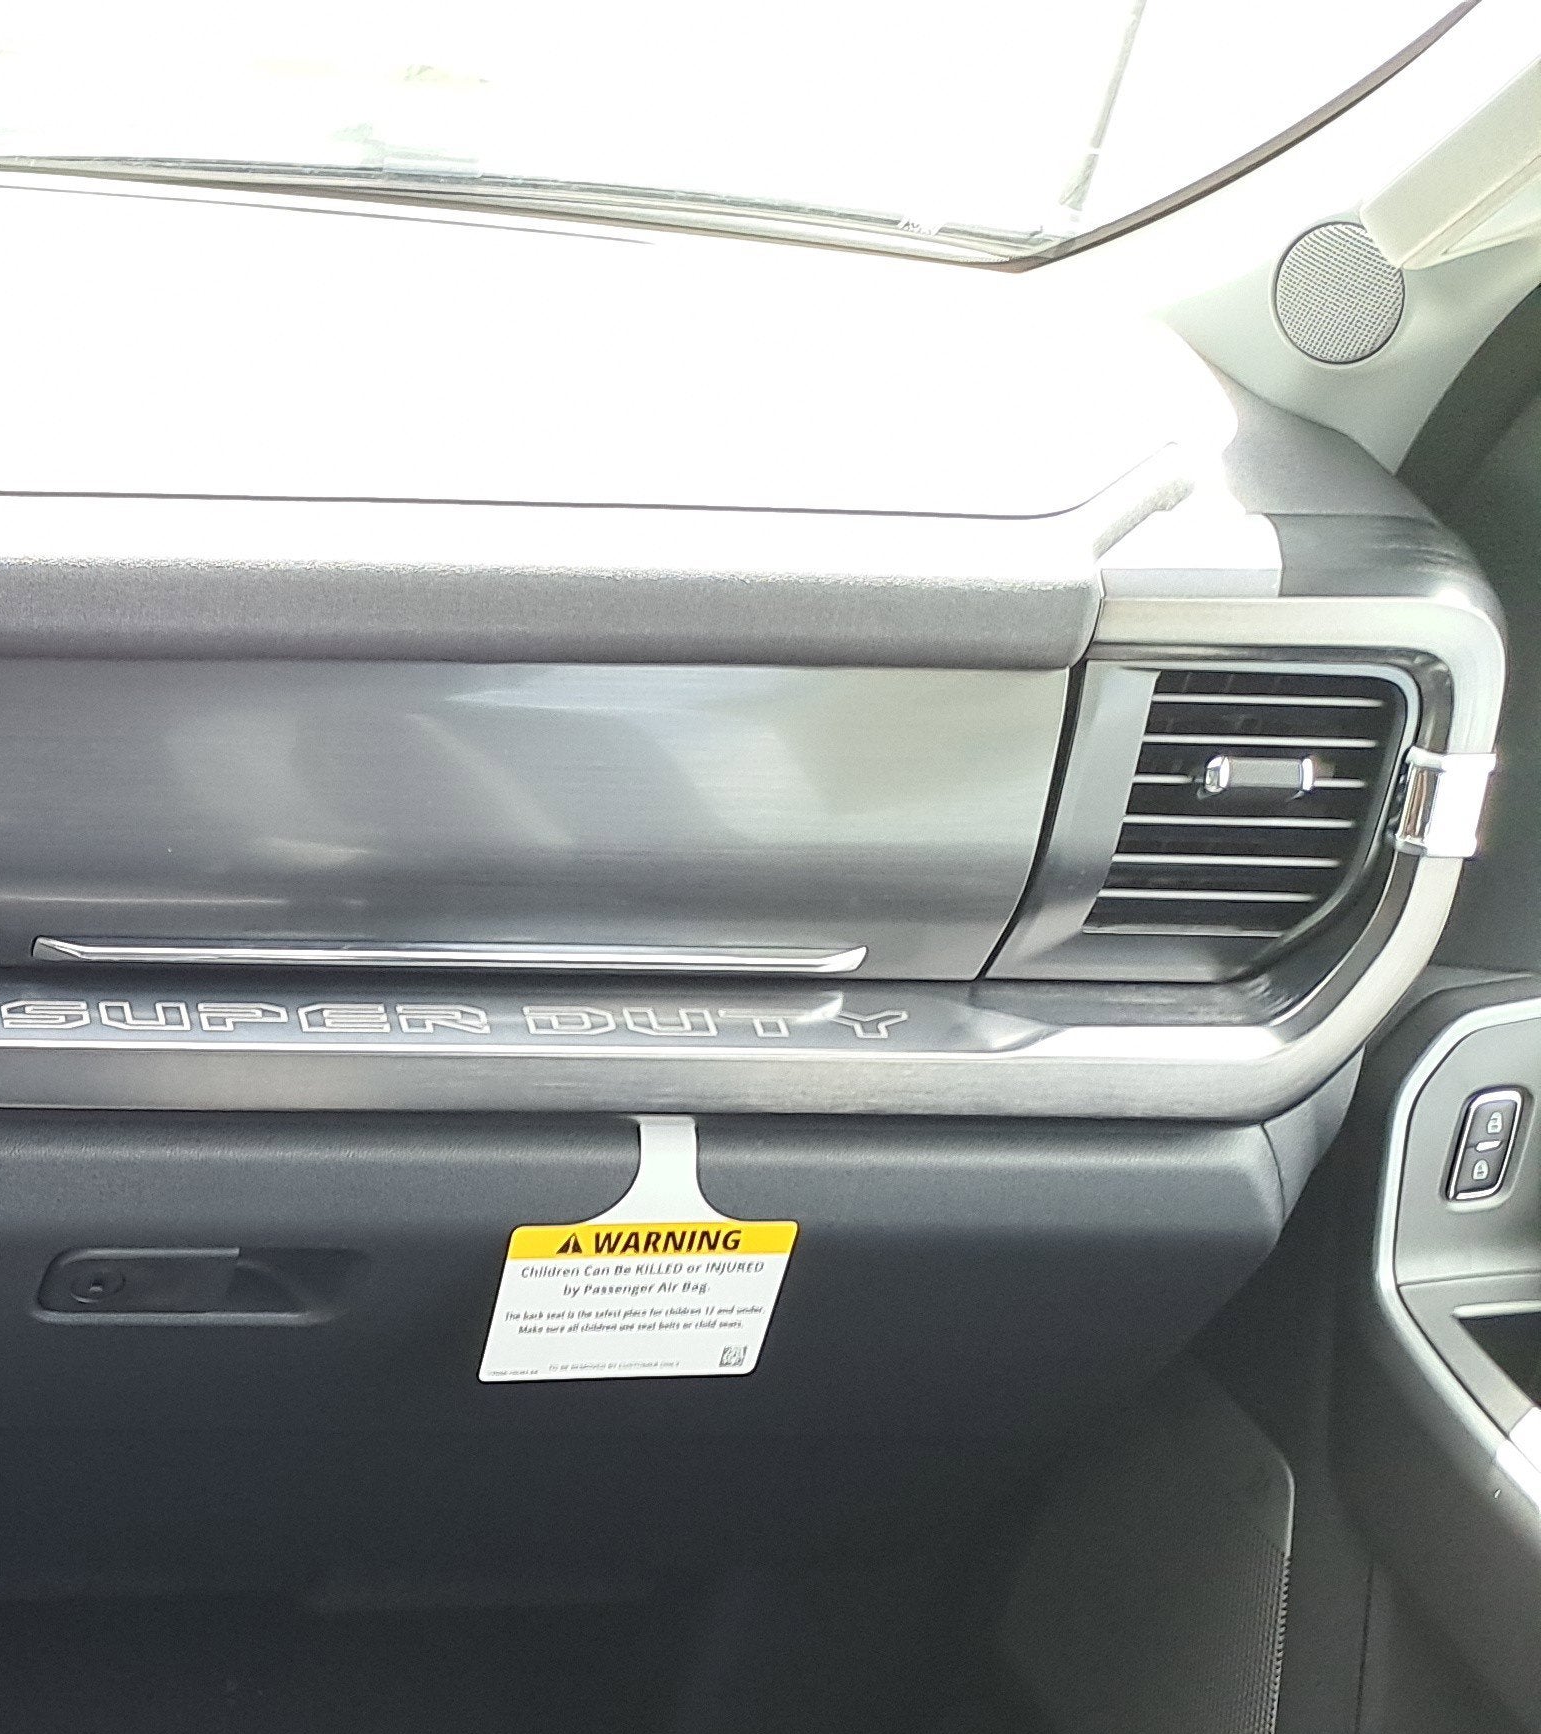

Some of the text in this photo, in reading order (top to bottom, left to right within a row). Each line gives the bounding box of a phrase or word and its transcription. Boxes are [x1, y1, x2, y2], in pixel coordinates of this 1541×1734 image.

[525, 1003, 909, 1040] DUTY
[593, 1229, 743, 1255] WARNING
[520, 1263, 580, 1279] Children
[584, 1264, 610, 1277] Can
[635, 1261, 683, 1276] KILLED
[686, 1264, 701, 1274] or
[705, 1260, 765, 1275] INJURED
[563, 1284, 580, 1298] by
[583, 1283, 654, 1297] Passenger
[657, 1281, 678, 1294] Air
